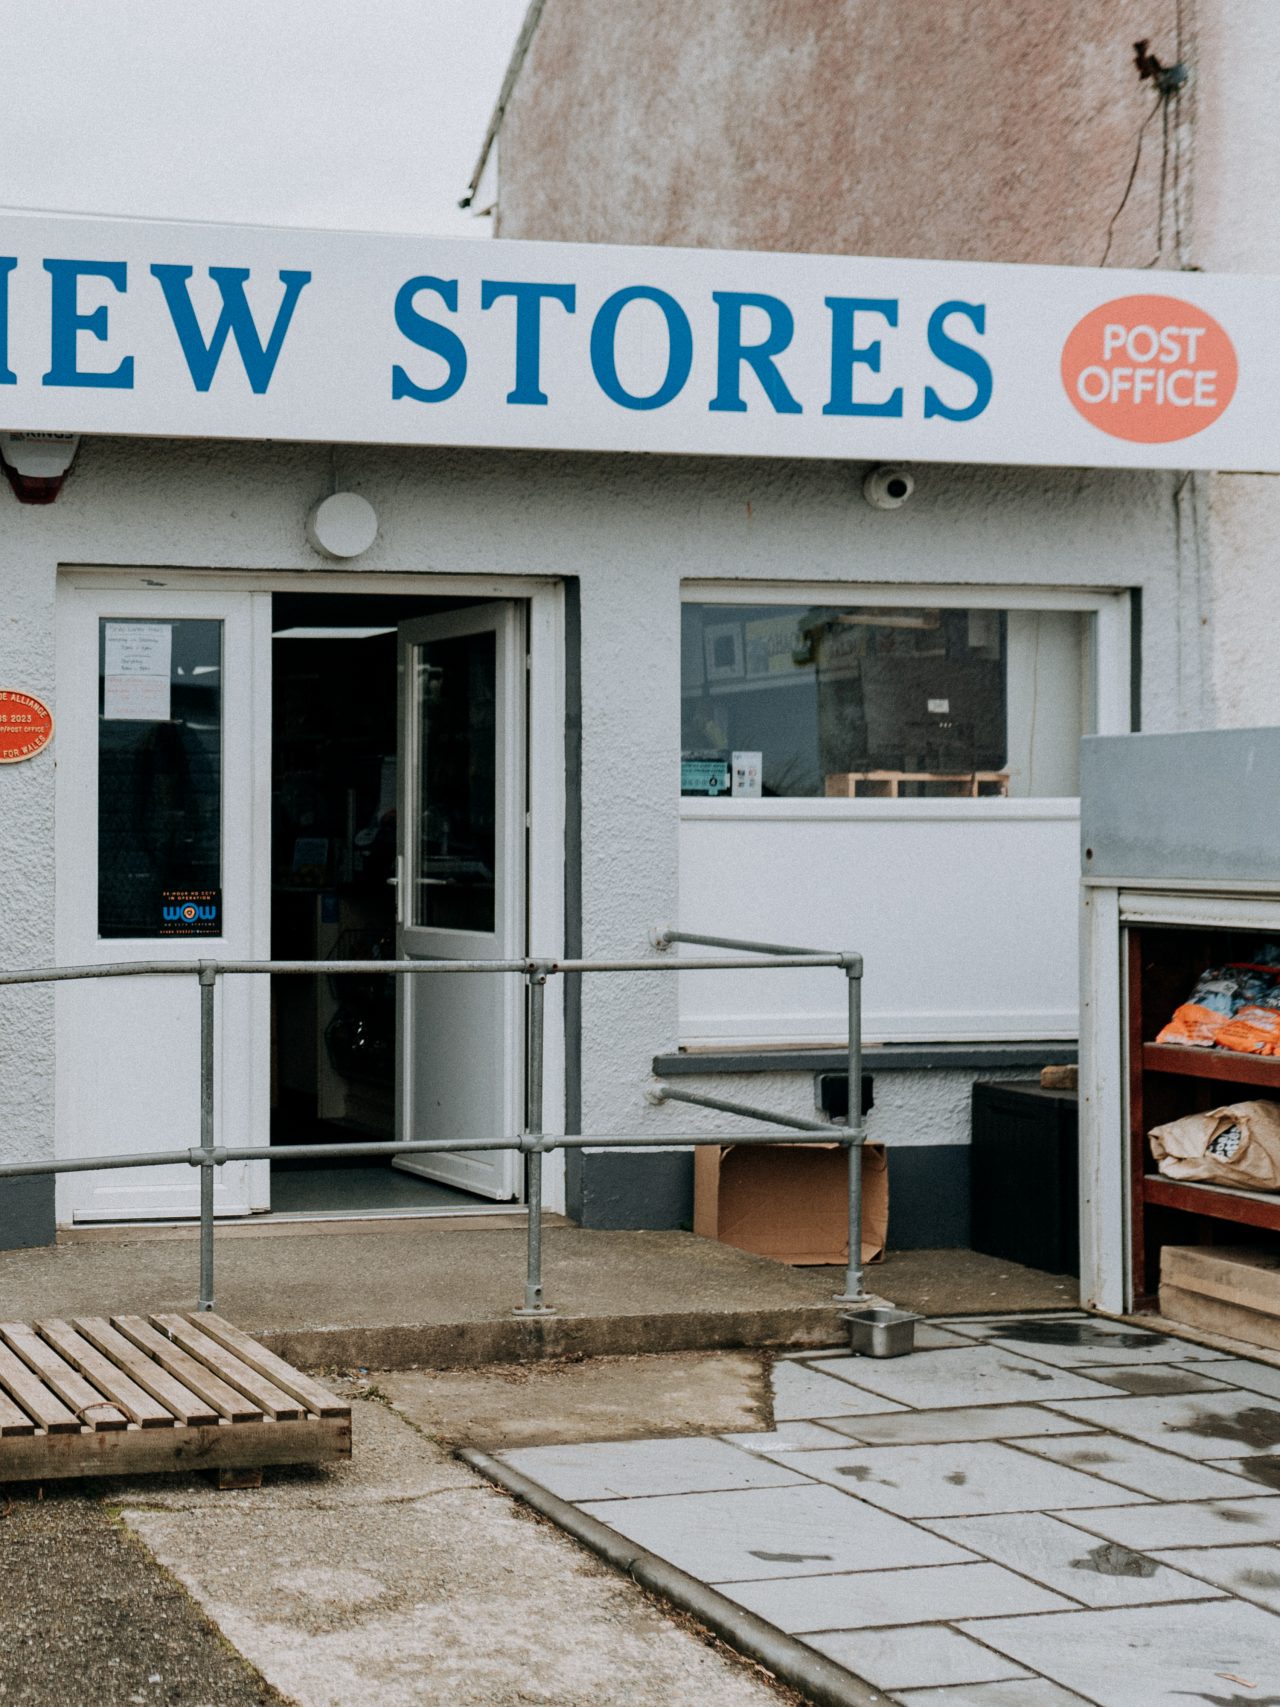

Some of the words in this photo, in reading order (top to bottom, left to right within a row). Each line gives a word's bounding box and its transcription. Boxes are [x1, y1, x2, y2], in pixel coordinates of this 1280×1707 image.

[391, 275, 995, 423] STORES
[1103, 323, 1206, 364] POST
[1077, 365, 1218, 408] OFFICE
[10, 693, 48, 719] ALLIANCE
[10, 714, 32, 723] 2023
[3, 748, 20, 758] FOR
[21, 735, 47, 755] WALES
